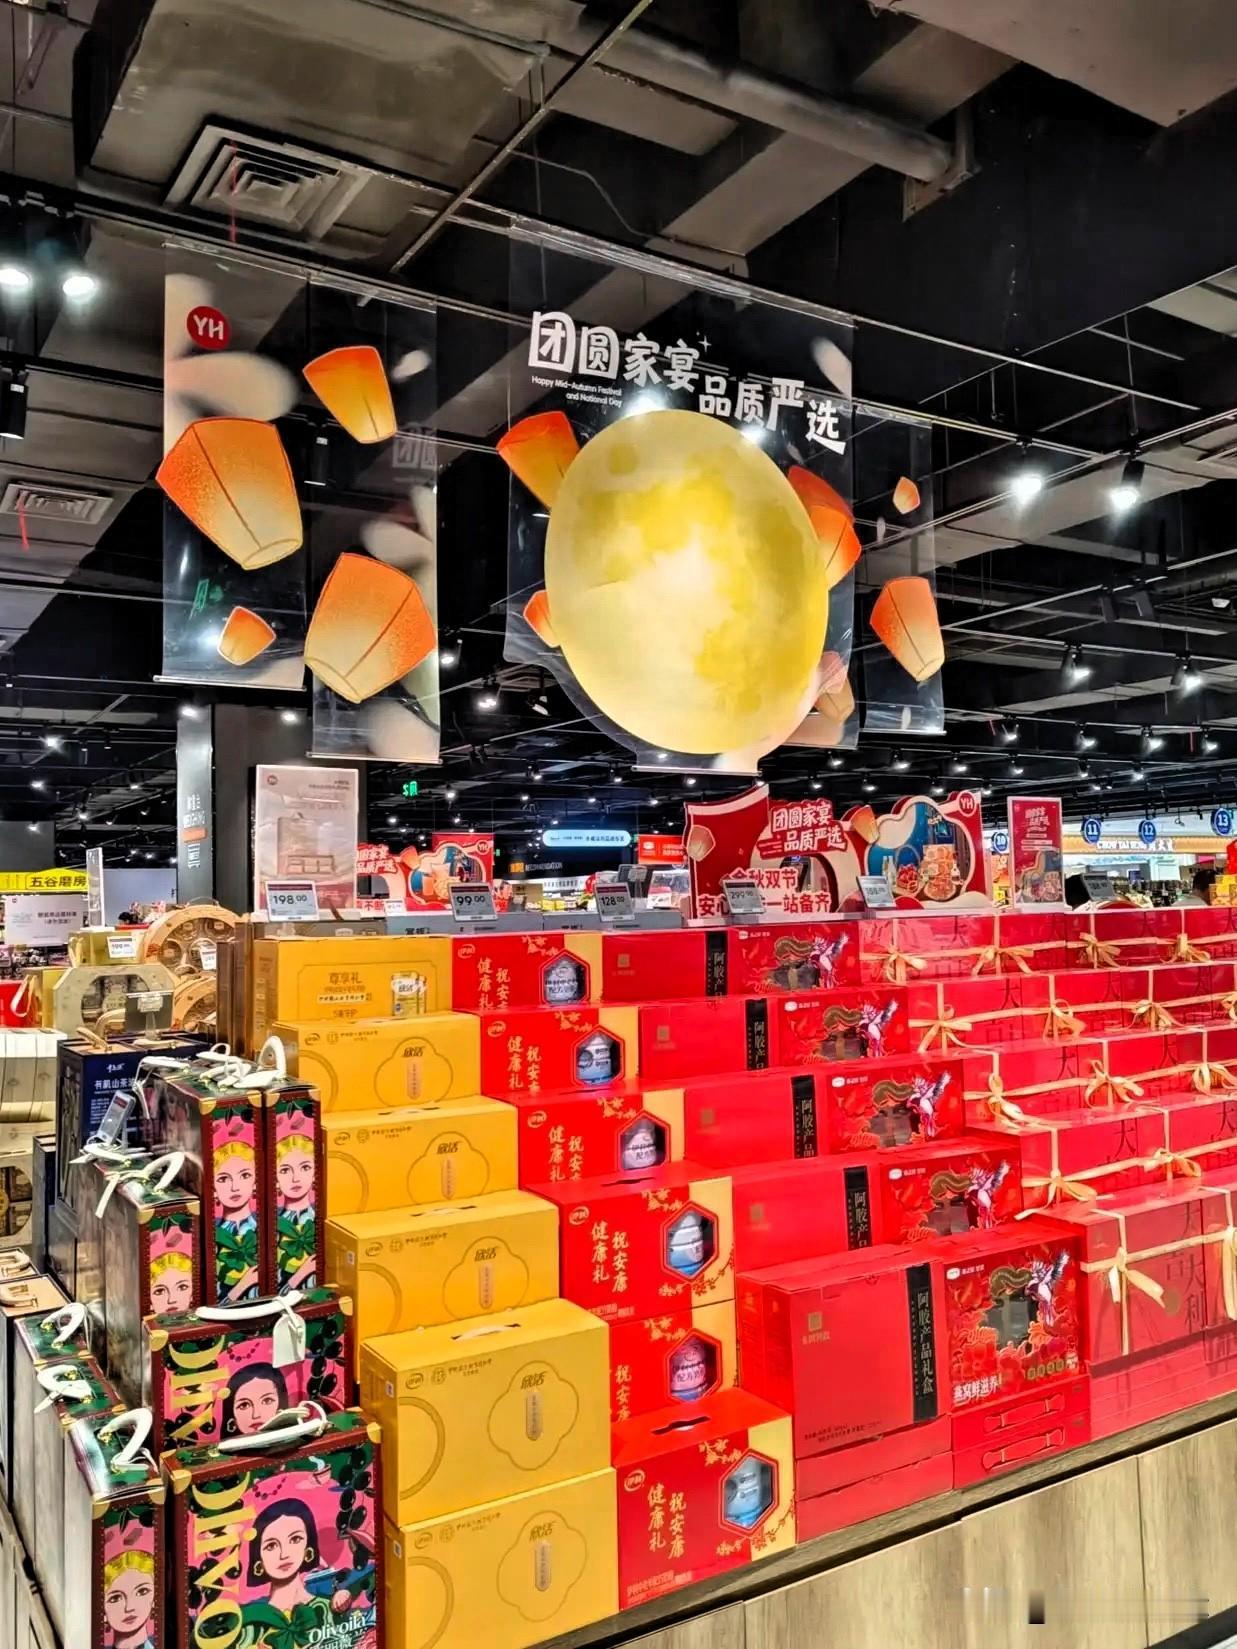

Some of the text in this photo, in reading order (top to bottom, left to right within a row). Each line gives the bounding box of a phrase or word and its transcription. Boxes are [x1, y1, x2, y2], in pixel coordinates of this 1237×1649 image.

[193, 313, 224, 341] YH
[528, 310, 700, 393] 团圆家宴
[531, 375, 622, 397] Happy Mid-Autumn Festival
[565, 392, 623, 409] and National Day
[699, 375, 847, 455] 品质严选
[772, 800, 833, 833] 团圆家宴
[961, 799, 975, 811] YH
[1217, 815, 1229, 827] 13
[783, 827, 848, 851] 品质严选
[1087, 824, 1099, 836] 11
[1144, 825, 1155, 836] 12
[29, 875, 87, 888] 五谷磨房
[506, 1035, 524, 1090] 健康礼
[548, 1125, 566, 1183] 健康礼
[592, 1220, 610, 1285] 健康礼
[612, 1231, 630, 1294] 祝安康
[615, 1364, 633, 1422] 祝安康
[647, 1482, 667, 1553] 健康礼
[667, 1491, 687, 1560] 祝安康
[307, 1611, 366, 1643] Olivoila
